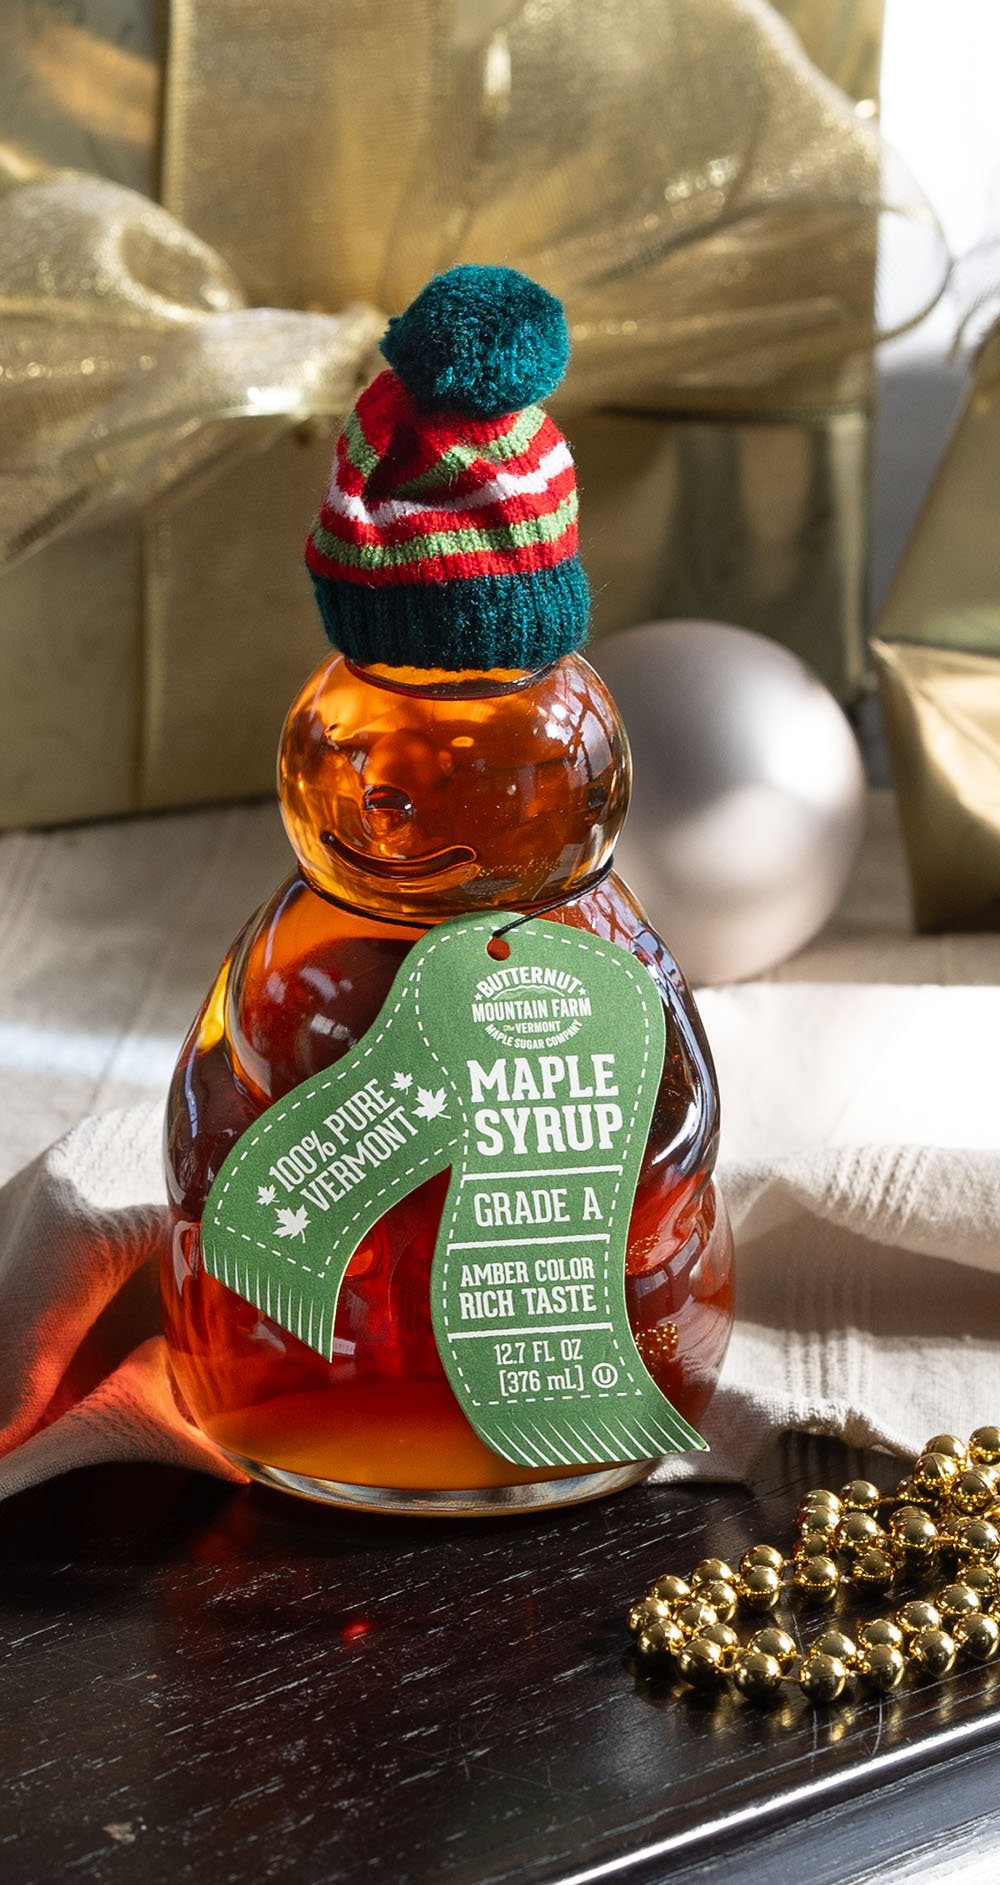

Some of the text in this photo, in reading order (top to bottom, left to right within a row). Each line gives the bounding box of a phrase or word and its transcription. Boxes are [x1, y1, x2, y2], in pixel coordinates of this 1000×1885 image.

[475, 966, 583, 998] BUTTERNUT
[471, 997, 593, 1023] MOUNTAIN FARM
[515, 1020, 561, 1034] VERMONT
[484, 1019, 583, 1050] MAPLE SUGAR COMPANY
[466, 1053, 619, 1103] MAPLE
[268, 1078, 396, 1193] 100% PURE
[473, 1103, 625, 1156] SYRUP
[299, 1106, 419, 1212] VERMONT
[473, 1186, 604, 1228] GRADE A
[460, 1257, 596, 1287] AMBER COLOR
[458, 1284, 597, 1320] RICH TASTE
[493, 1338, 584, 1365] 12.7 FL OZ
